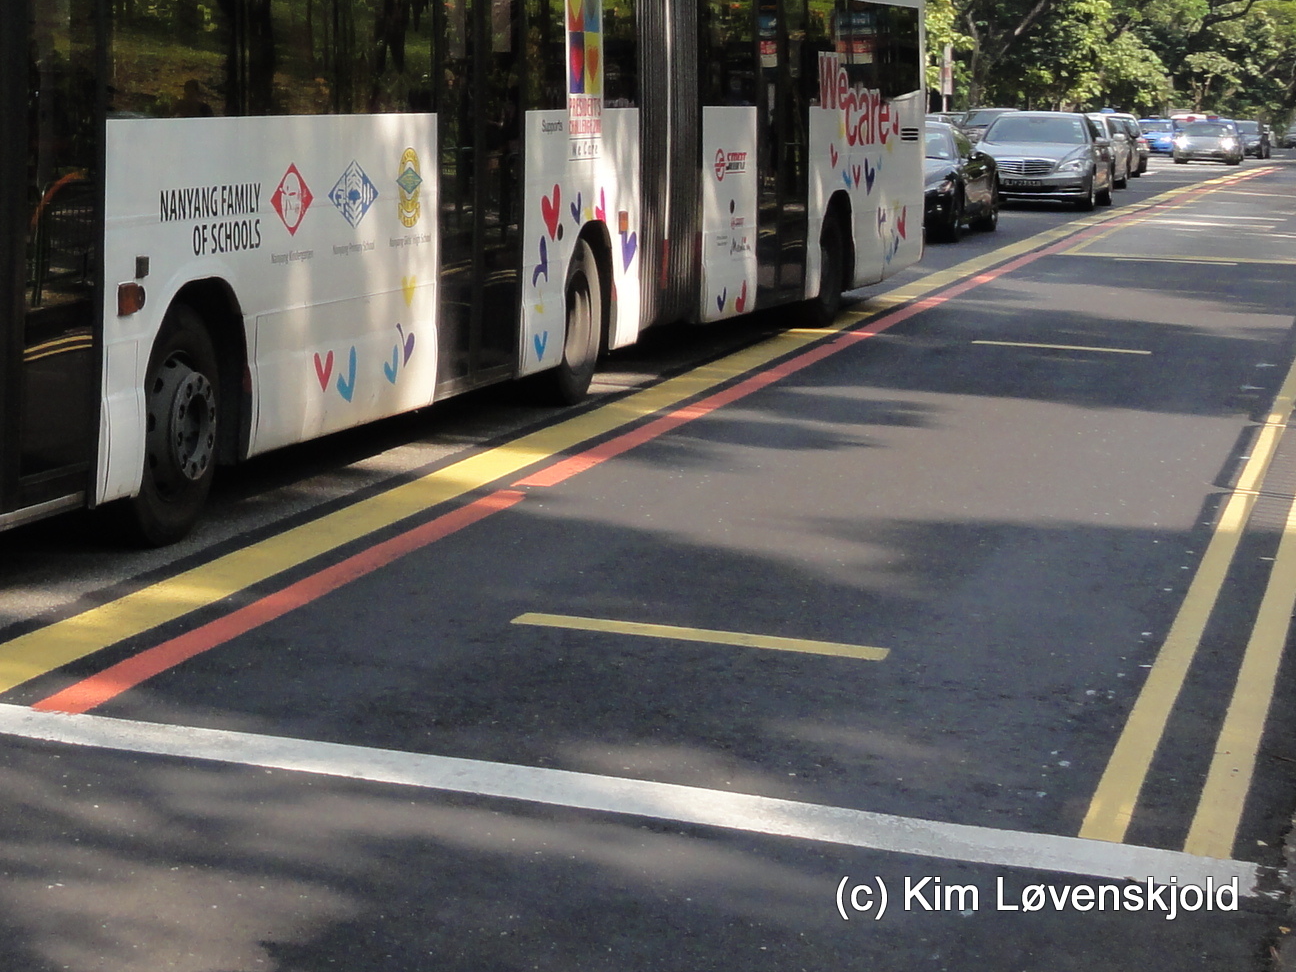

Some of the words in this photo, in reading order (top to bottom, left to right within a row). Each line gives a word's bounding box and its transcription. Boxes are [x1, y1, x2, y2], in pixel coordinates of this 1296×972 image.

[819, 56, 848, 110] We
[845, 91, 891, 146] care
[160, 186, 218, 222] NANYANG
[221, 182, 261, 216] FAMILY
[193, 224, 208, 256] OF
[211, 219, 261, 254] SCHOOLS
